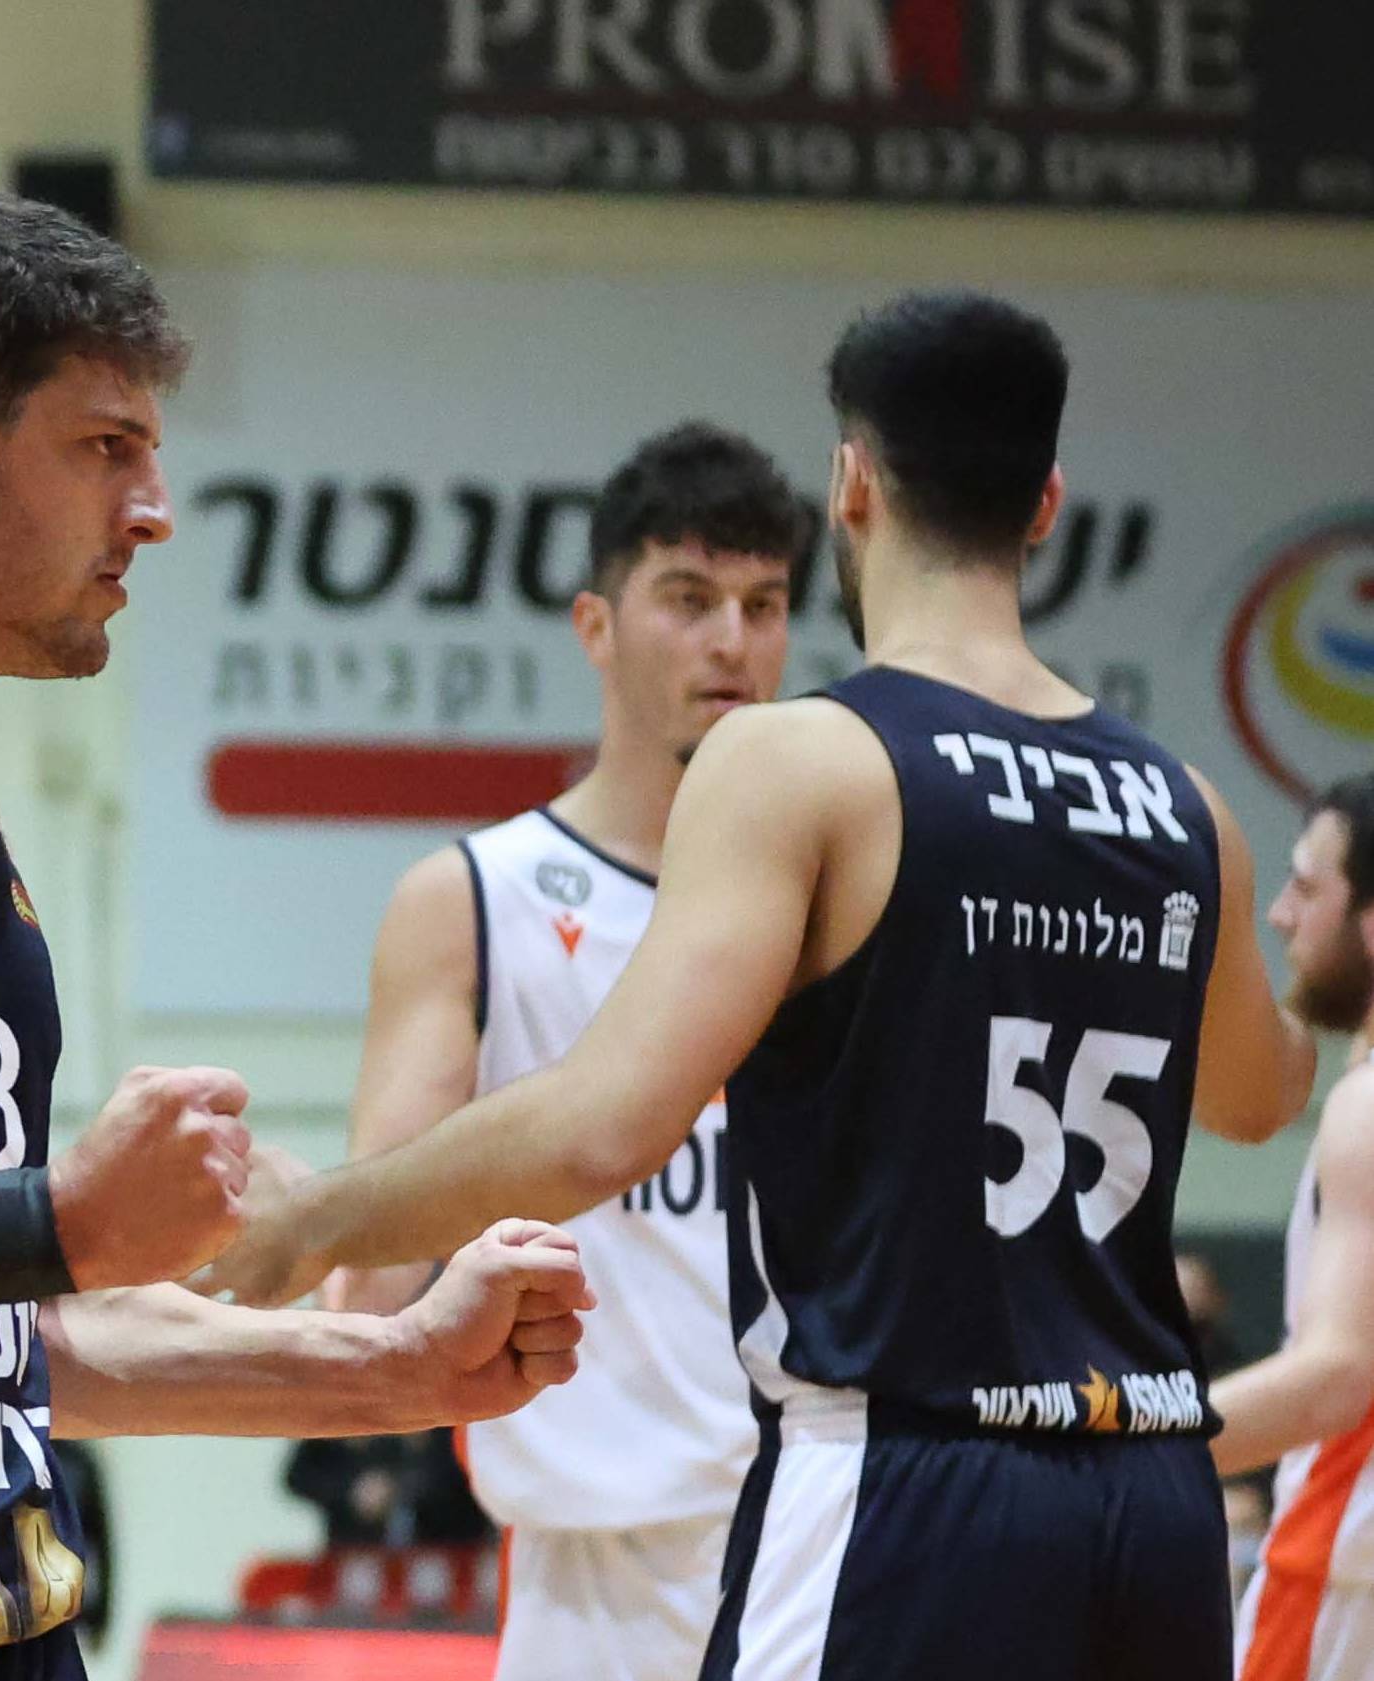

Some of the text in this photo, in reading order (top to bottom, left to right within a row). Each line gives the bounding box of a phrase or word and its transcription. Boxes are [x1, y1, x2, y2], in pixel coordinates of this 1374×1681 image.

[933, 732, 1189, 843] אביבי
[961, 894, 1145, 963] מלונות דן
[984, 1014, 1172, 1244] 55
[1121, 1369, 1204, 1432] ISRAIR
